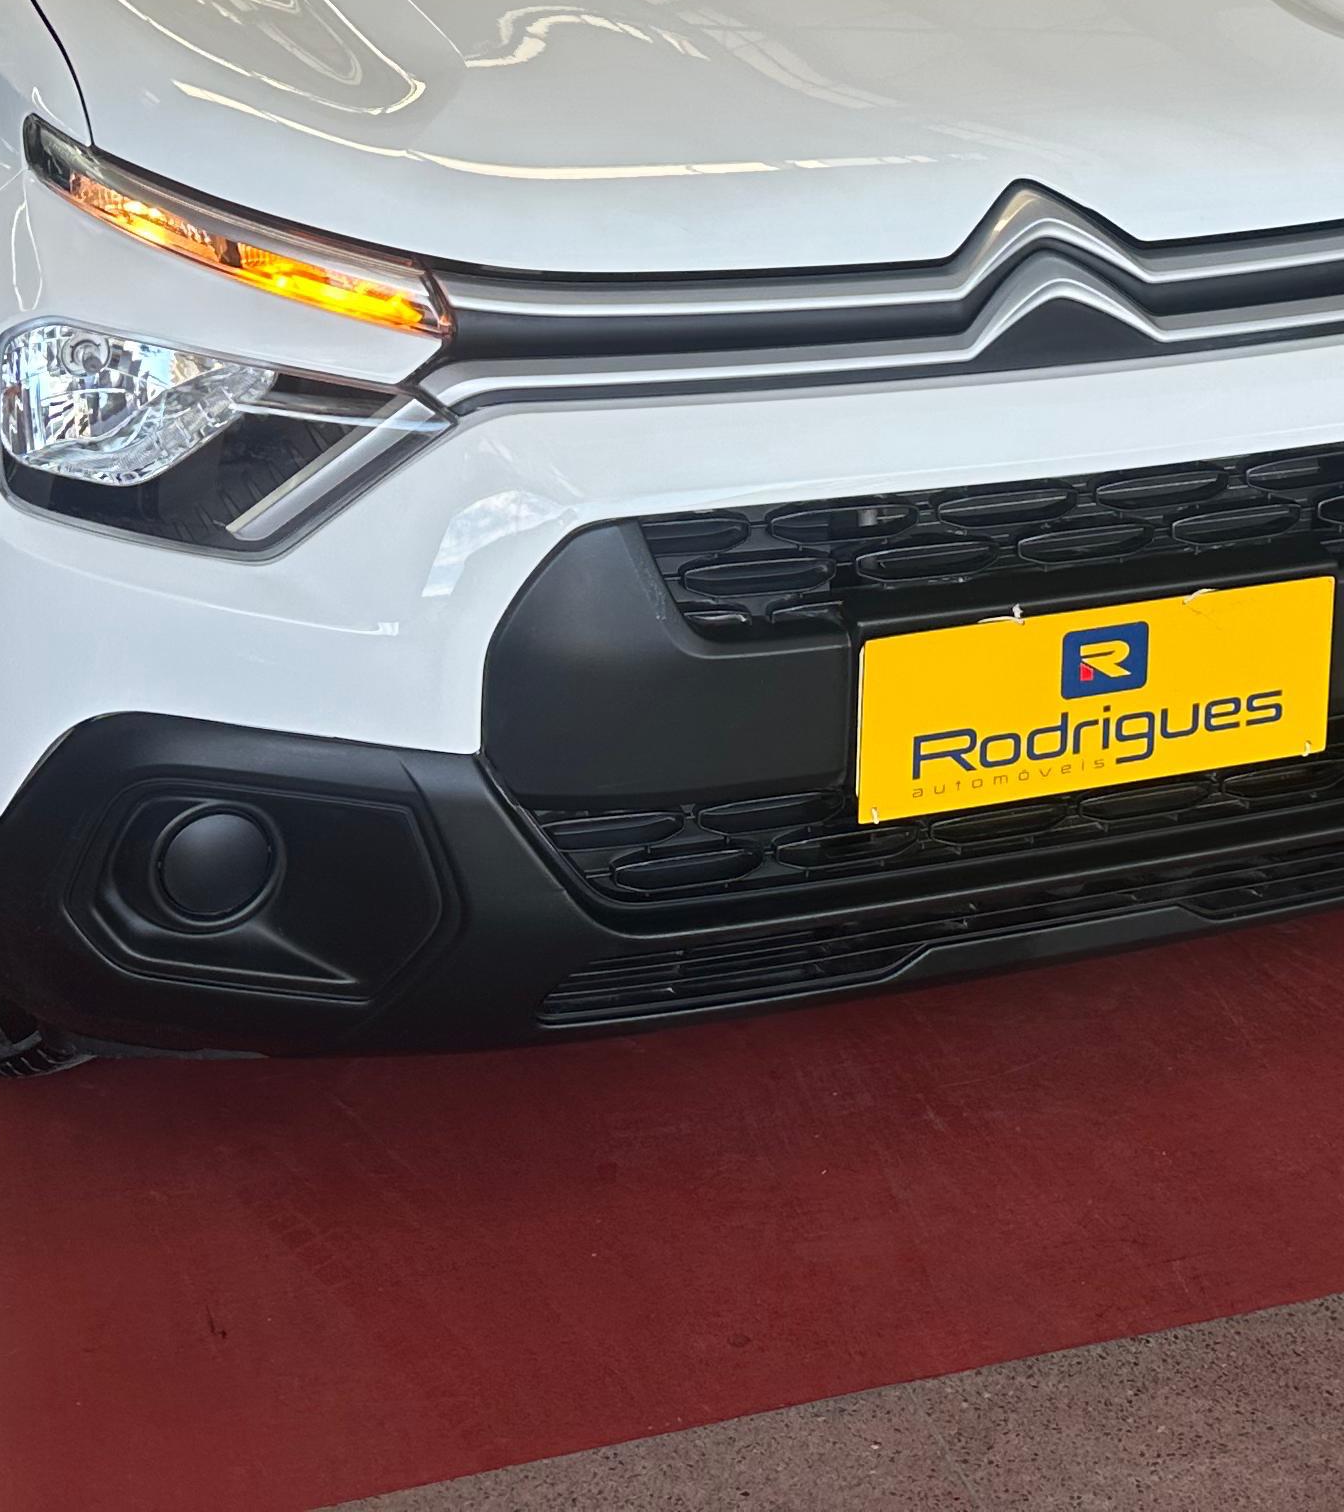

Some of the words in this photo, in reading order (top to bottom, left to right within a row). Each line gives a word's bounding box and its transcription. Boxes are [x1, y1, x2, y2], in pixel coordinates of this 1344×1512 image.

[1079, 639, 1131, 682] R
[912, 689, 1283, 781] Rodrigues
[912, 757, 1106, 798] automóveis
